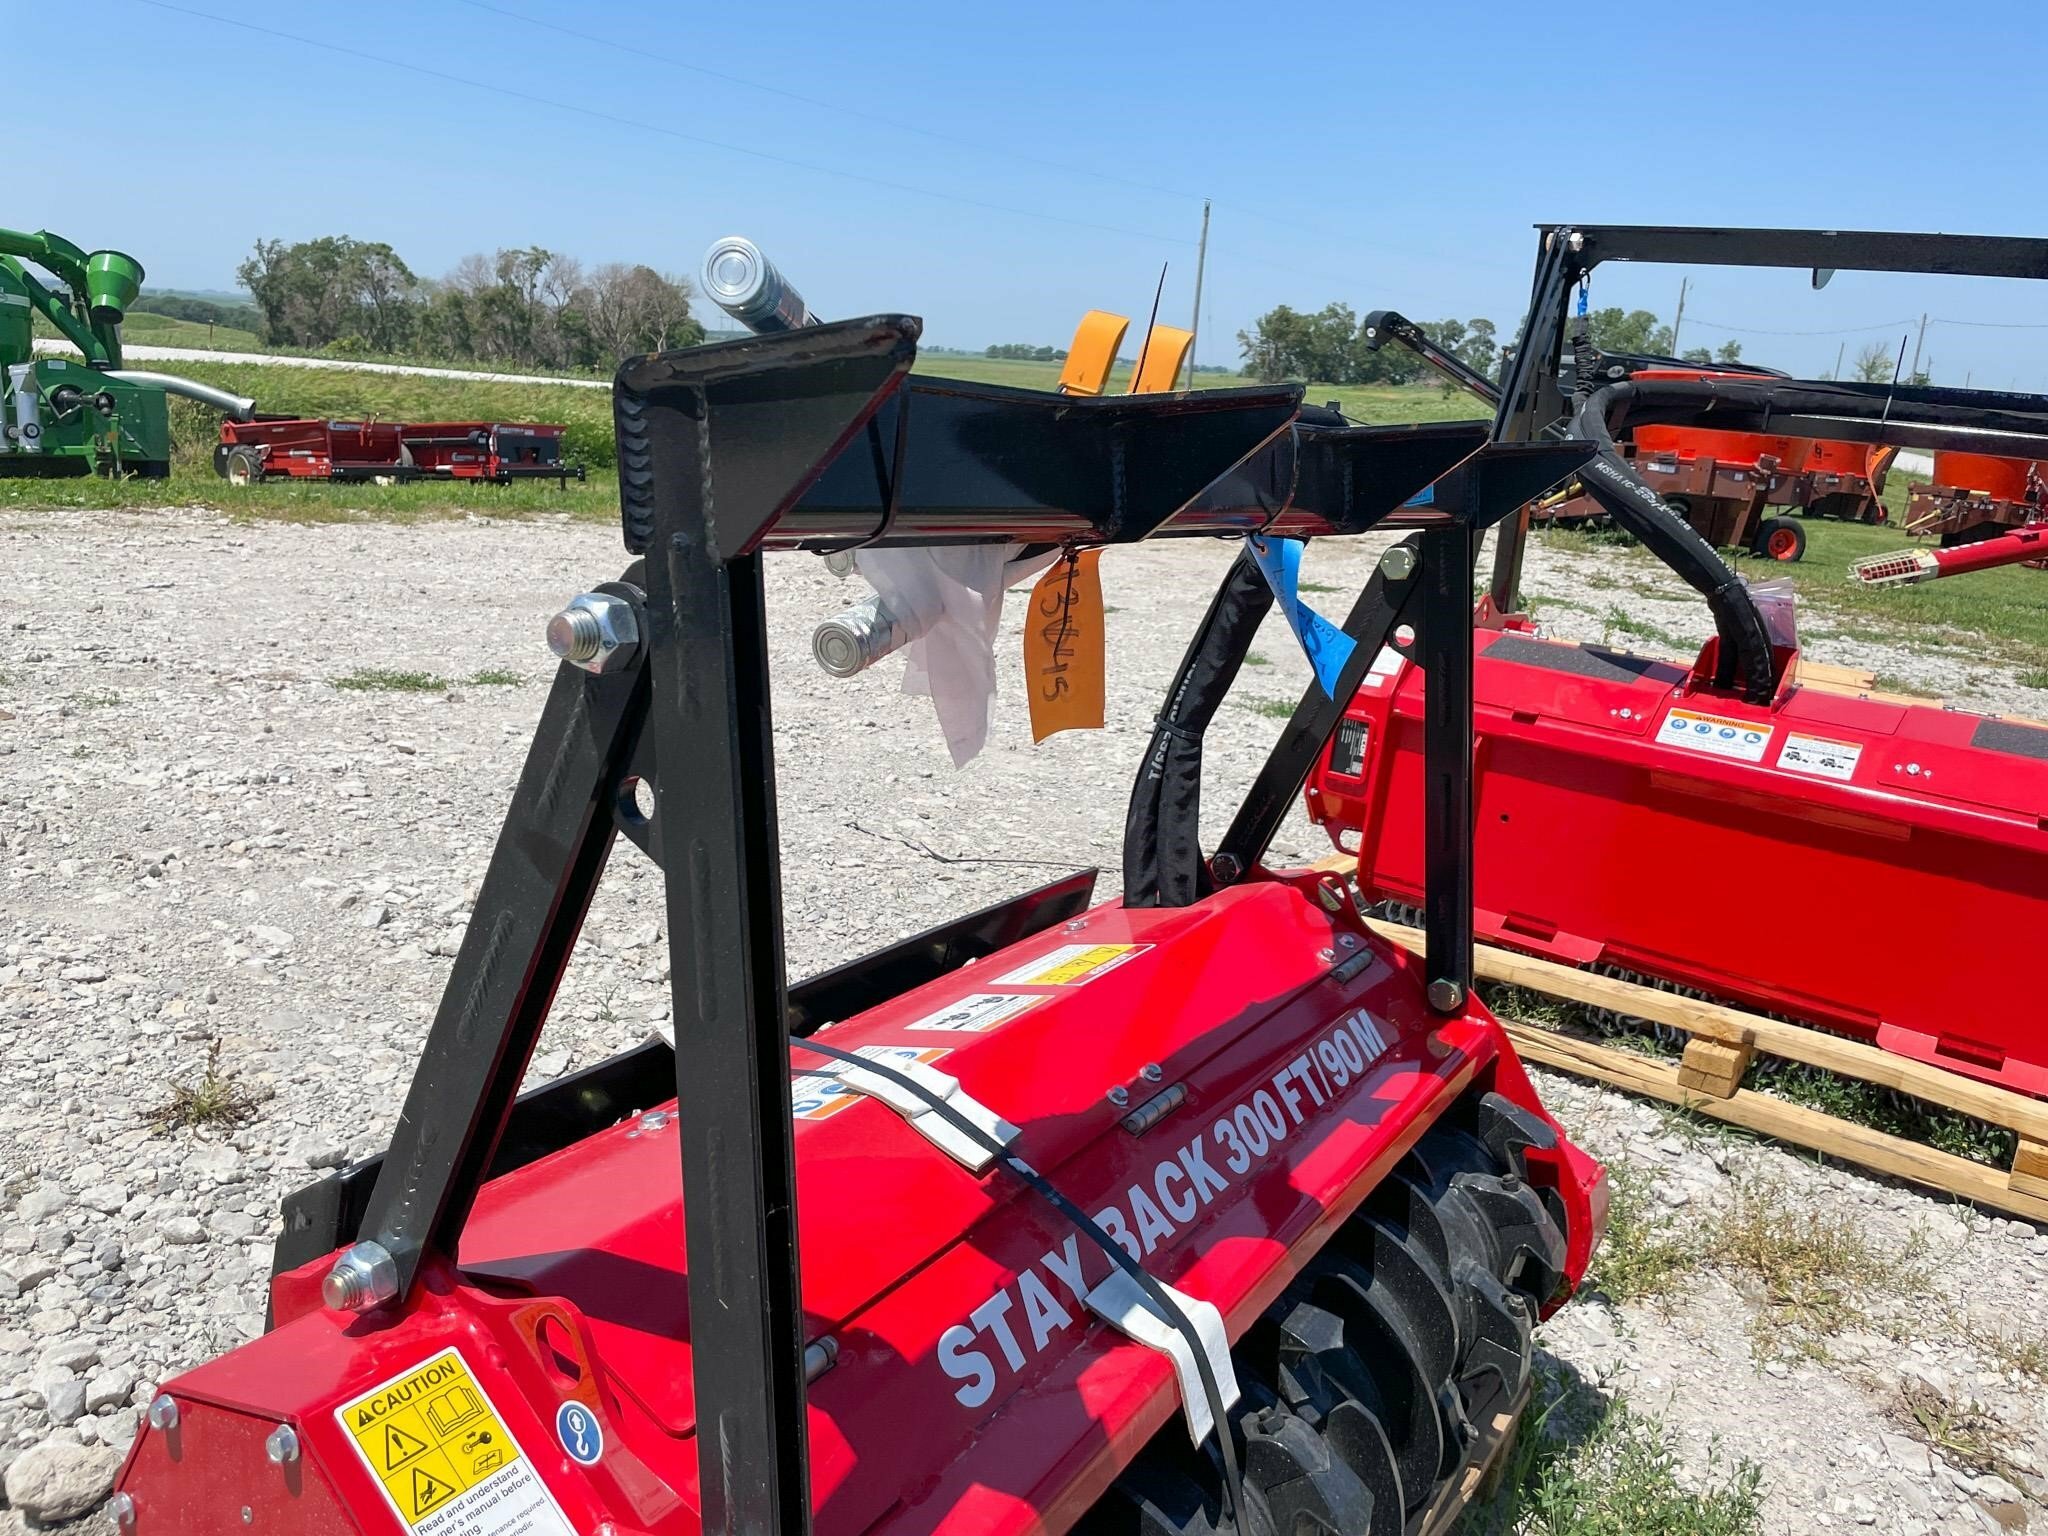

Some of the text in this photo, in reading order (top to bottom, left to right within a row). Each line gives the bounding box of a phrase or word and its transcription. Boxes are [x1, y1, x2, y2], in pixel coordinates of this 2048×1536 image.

[1595, 462, 1624, 482] MSHA
[1702, 715, 1745, 729] WARNING
[937, 1234, 1091, 1408] STAY
[1095, 1134, 1229, 1268] BACK
[371, 1360, 455, 1416] CAUTION
[417, 1465, 519, 1536] Read and understand
[465, 1494, 501, 1522] manual
[501, 1473, 532, 1498] before
[516, 1497, 546, 1521] required
